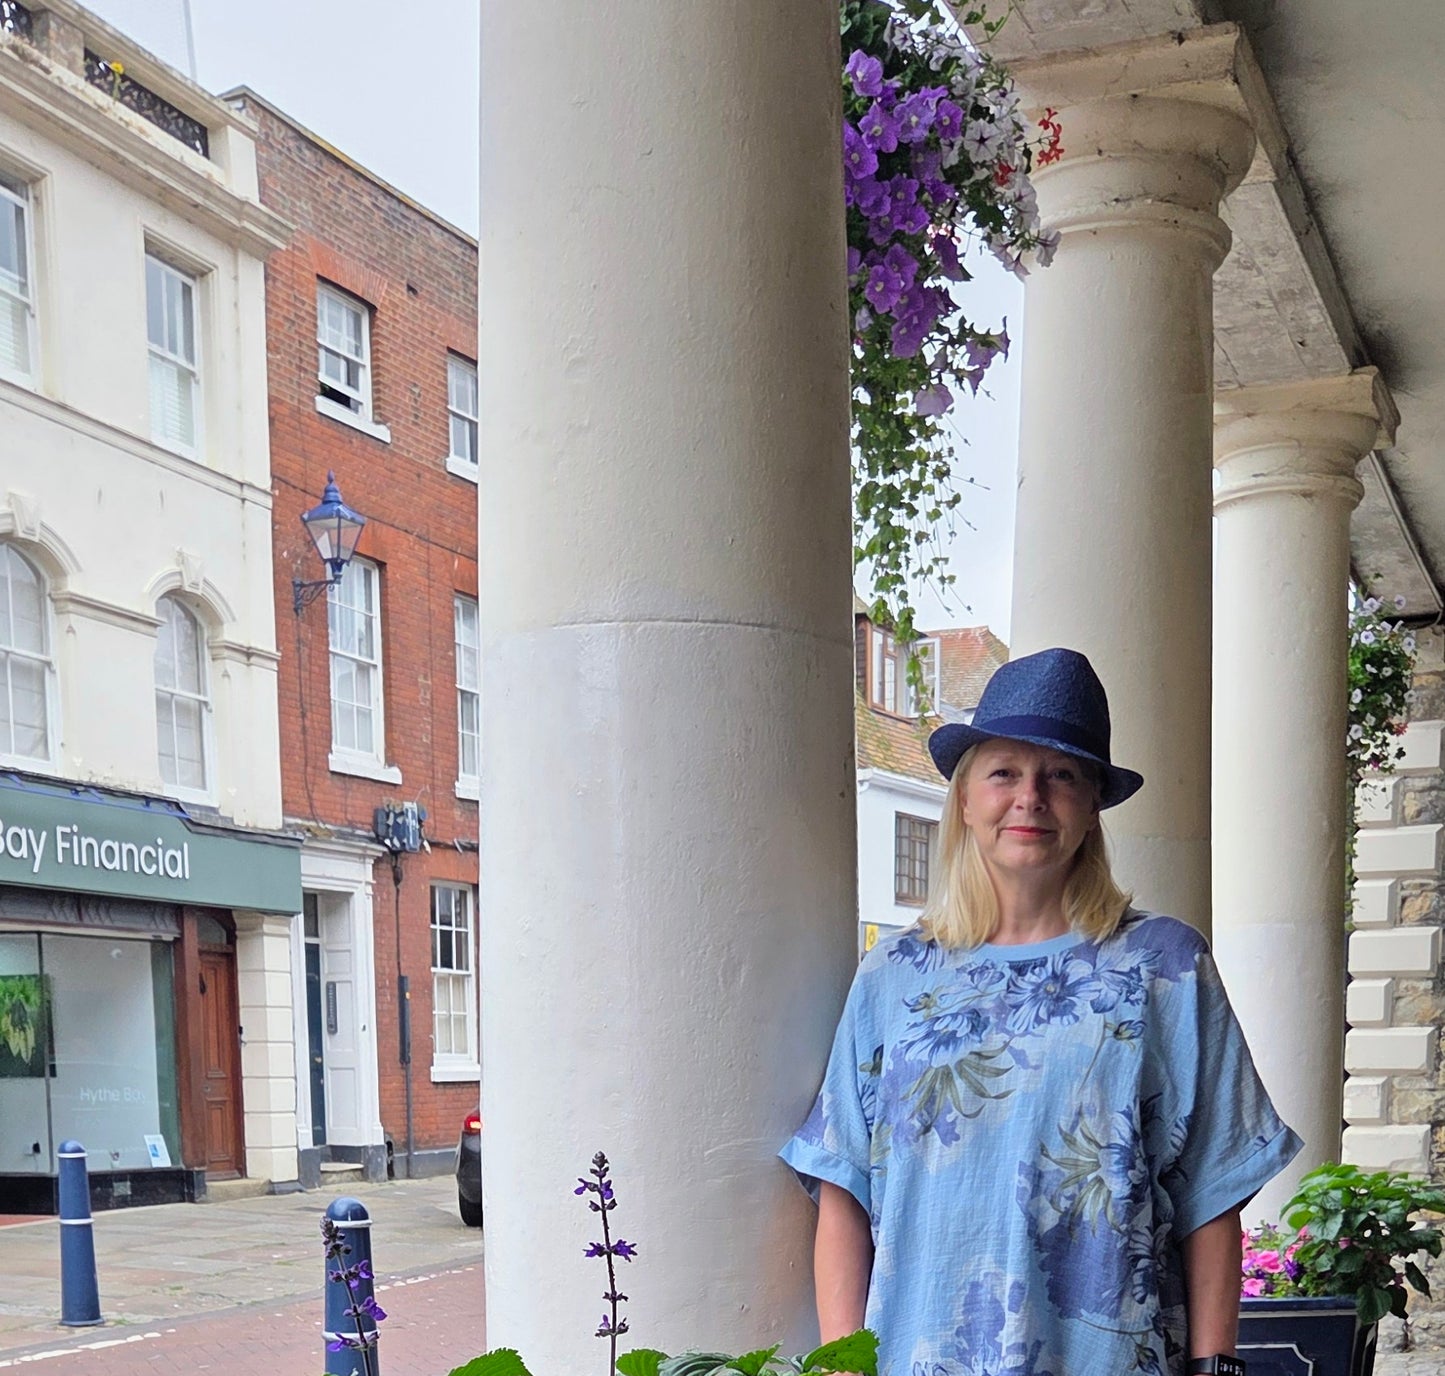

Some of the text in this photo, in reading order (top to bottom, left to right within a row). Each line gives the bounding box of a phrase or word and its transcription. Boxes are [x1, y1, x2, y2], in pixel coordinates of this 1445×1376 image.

[0, 819, 190, 879] ay Financial
[80, 1087, 120, 1105] Hythe
